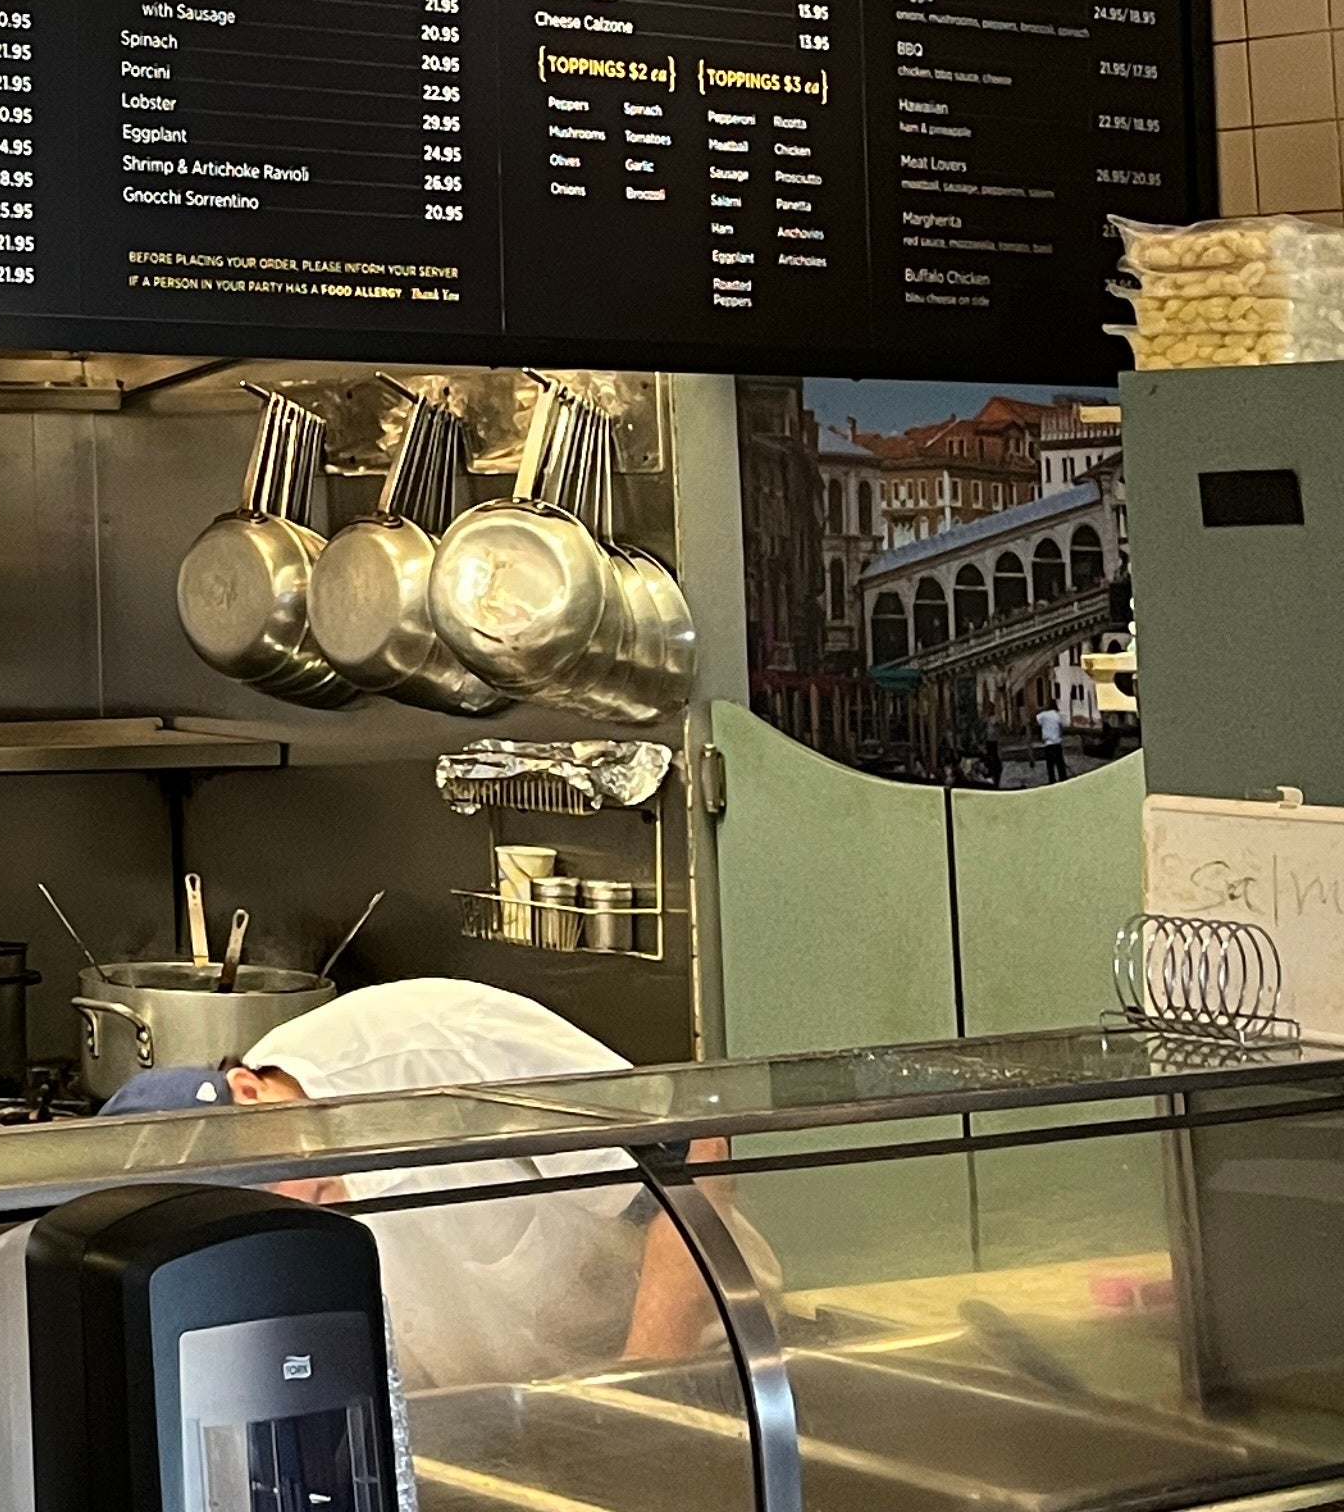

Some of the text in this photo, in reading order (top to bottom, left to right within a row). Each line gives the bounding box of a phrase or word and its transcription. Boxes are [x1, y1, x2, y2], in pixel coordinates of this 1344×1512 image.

[121, 30, 459, 72] Spinach 20.95
[547, 55, 626, 78] TOPPINGS
[629, 62, 647, 80] $2
[122, 93, 460, 132] Lobster 29.95
[123, 124, 461, 162] Eggplant 24.95
[129, 251, 172, 264] BEFORE
[176, 254, 224, 267] PLACING
[227, 257, 256, 268] YOUR
[303, 260, 341, 273] PLEASE
[345, 263, 385, 274] INFORM
[388, 265, 416, 276] YOUR
[419, 266, 458, 278] SERVER
